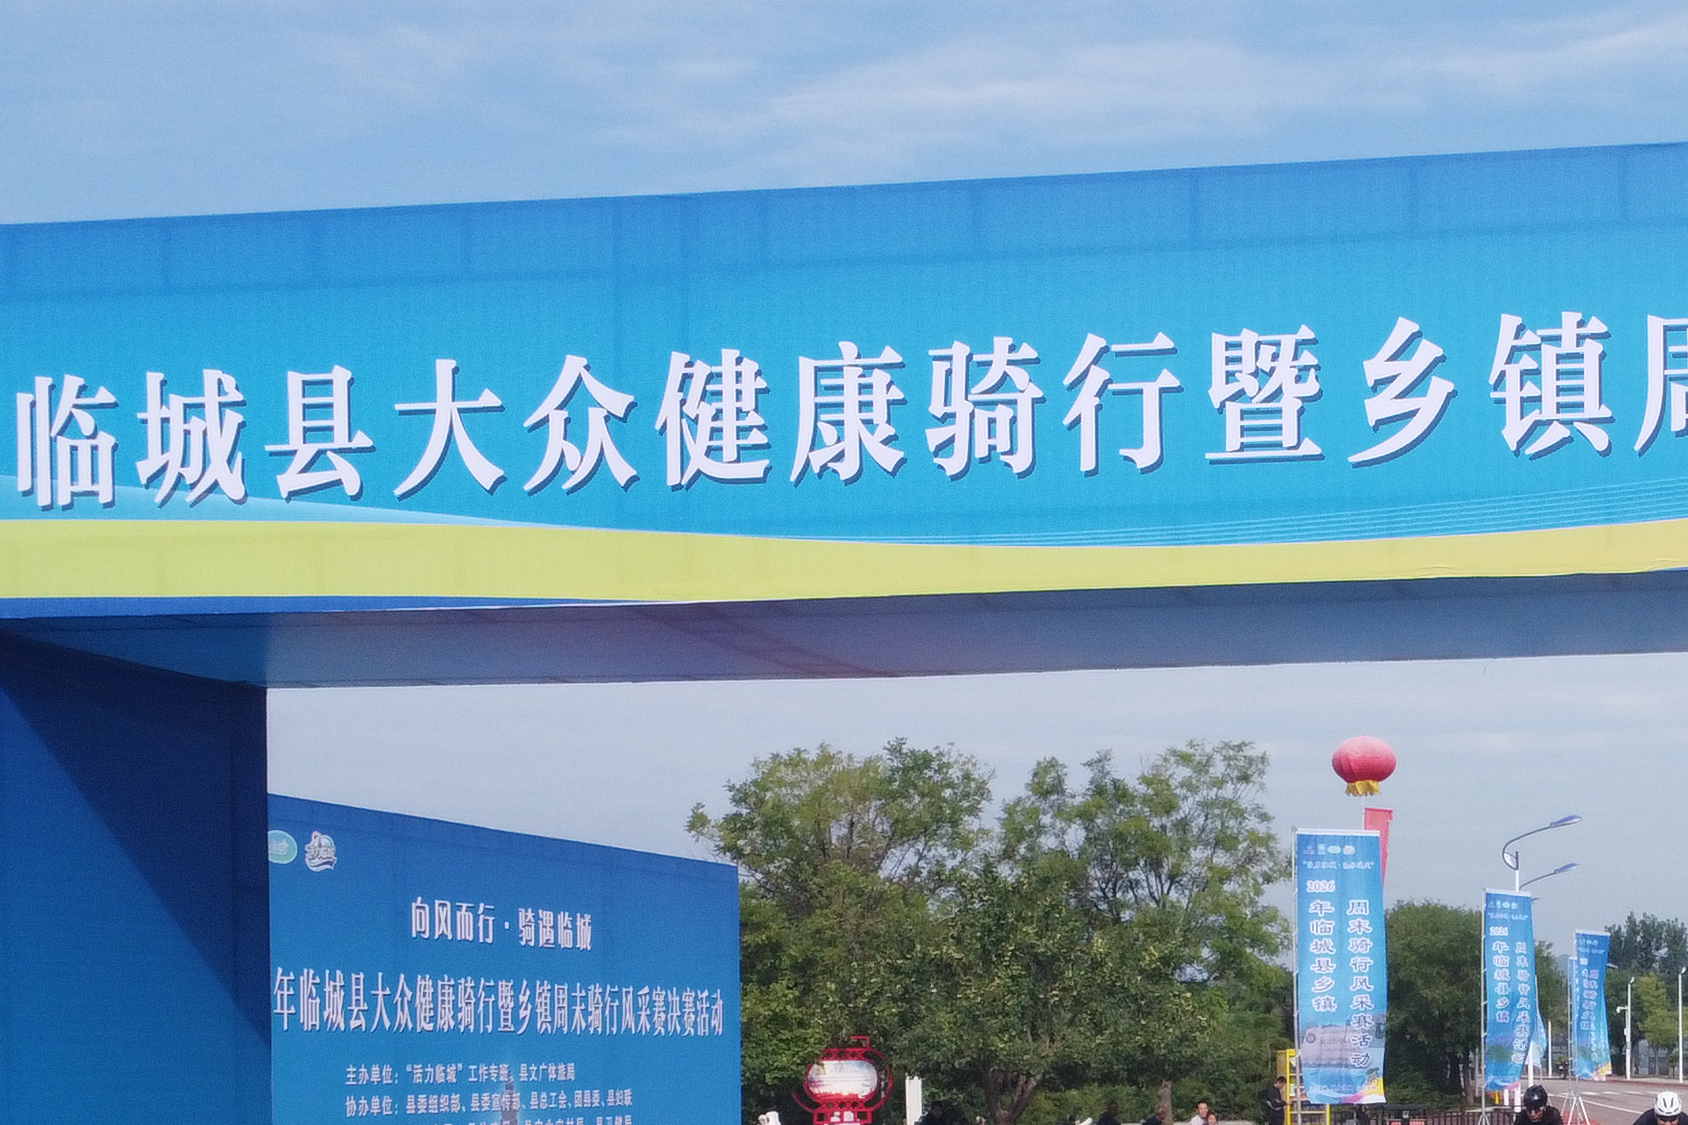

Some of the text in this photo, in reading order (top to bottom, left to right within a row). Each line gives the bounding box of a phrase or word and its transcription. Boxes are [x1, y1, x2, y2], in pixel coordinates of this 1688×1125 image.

[411, 896, 592, 951] 向风而行·骑遇临城
[273, 966, 724, 1037] 年临城县大众健康骑行暨乡镇周末骑行风采赛决赛活动
[1346, 899, 1375, 1068] 周末骑行风采赛活动
